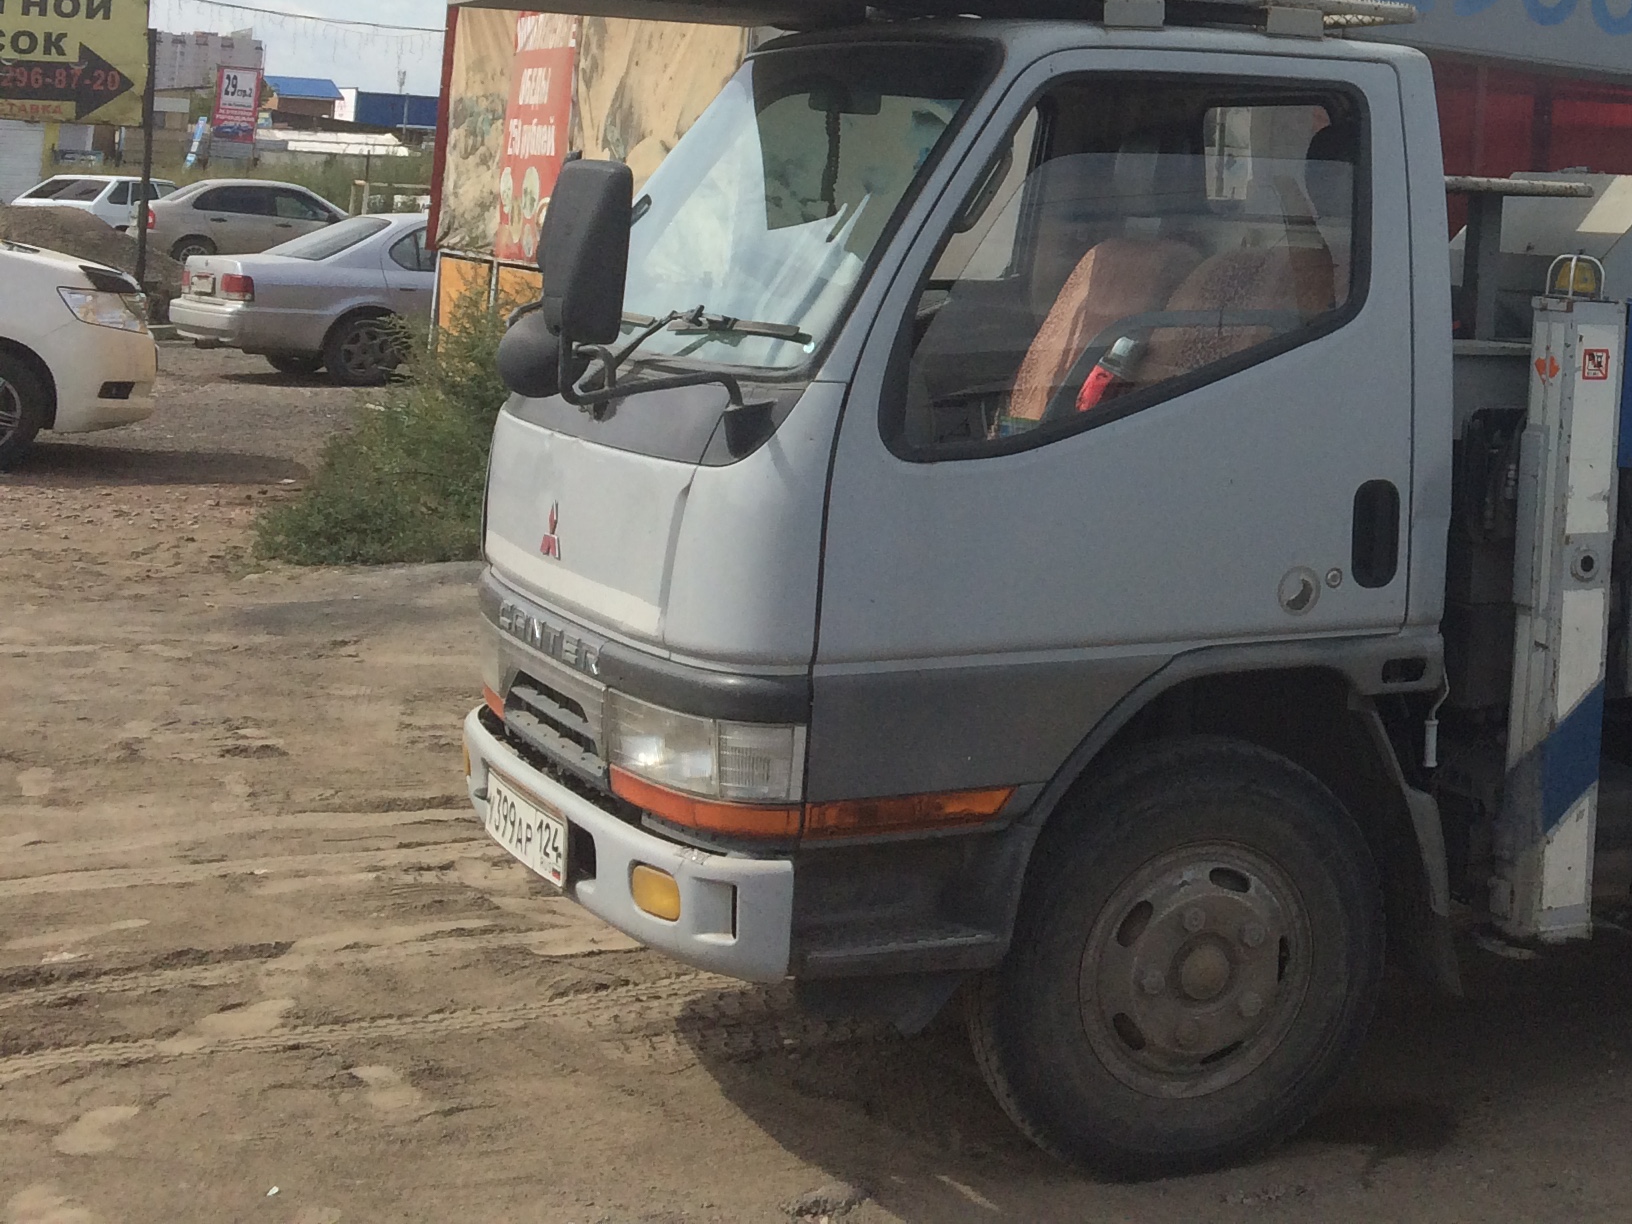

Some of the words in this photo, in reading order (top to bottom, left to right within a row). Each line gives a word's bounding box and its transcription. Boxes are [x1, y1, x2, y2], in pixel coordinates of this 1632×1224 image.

[224, 74, 238, 96] 29
[500, 599, 602, 676] CANTER
[537, 818, 562, 864] 124
